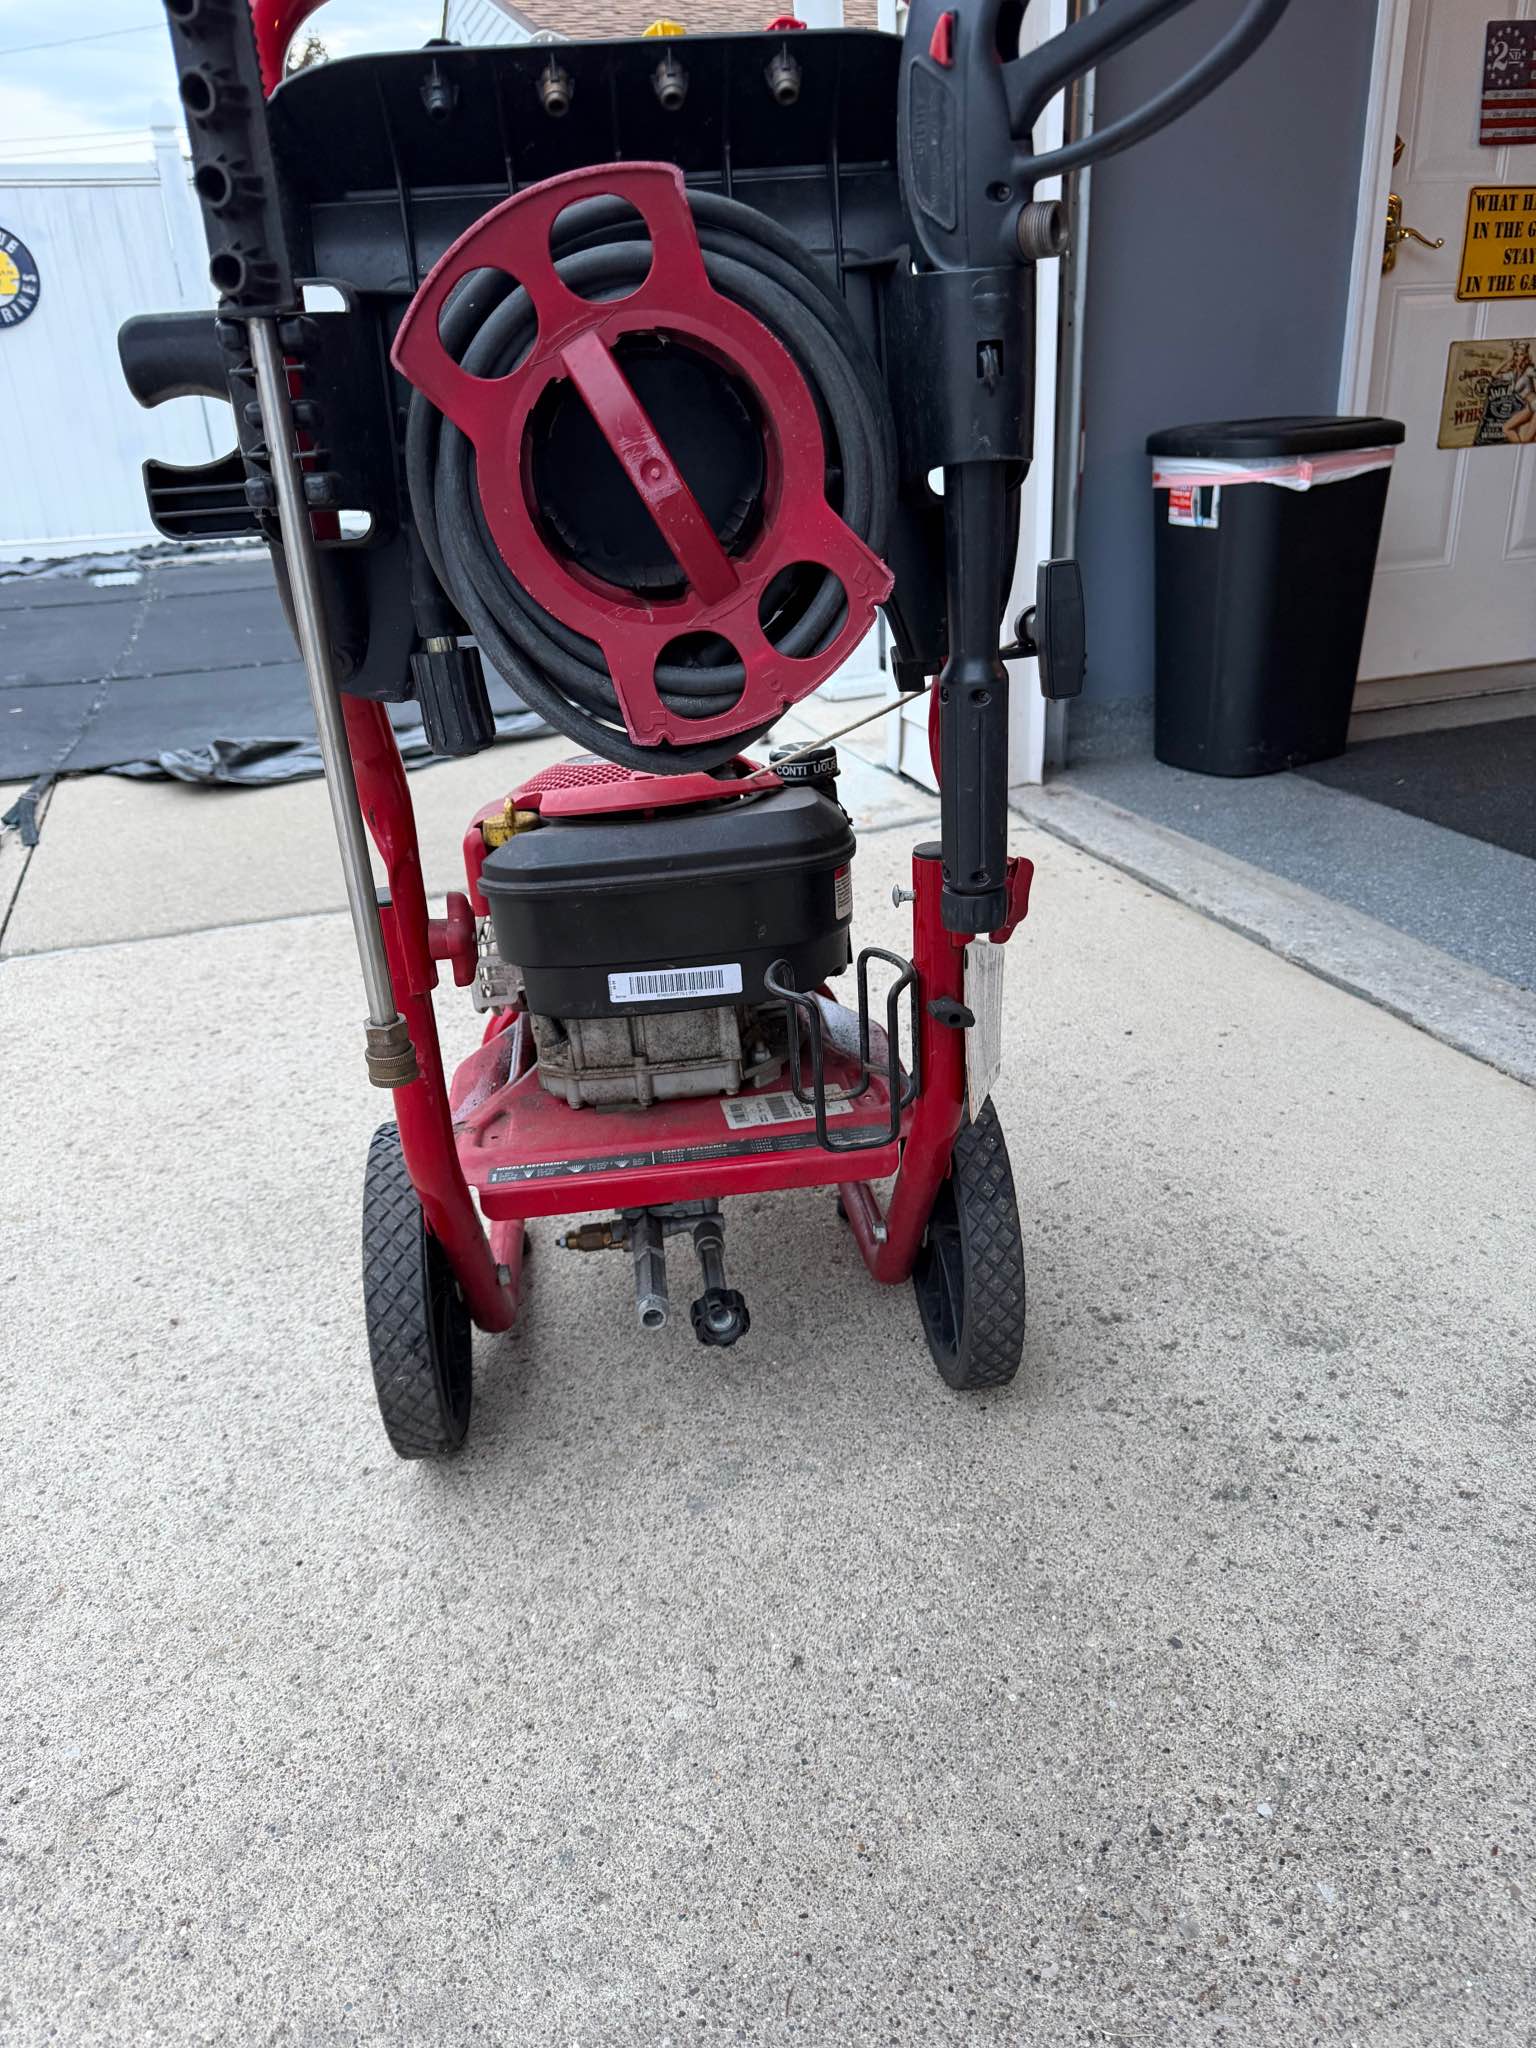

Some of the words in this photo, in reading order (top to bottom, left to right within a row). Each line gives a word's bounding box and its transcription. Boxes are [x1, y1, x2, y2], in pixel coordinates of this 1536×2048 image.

[1476, 194, 1518, 211] WHAT
[1473, 222, 1489, 239] IN
[1495, 221, 1524, 238] THE
[1466, 275, 1482, 292] IN
[1488, 275, 1516, 292] THE
